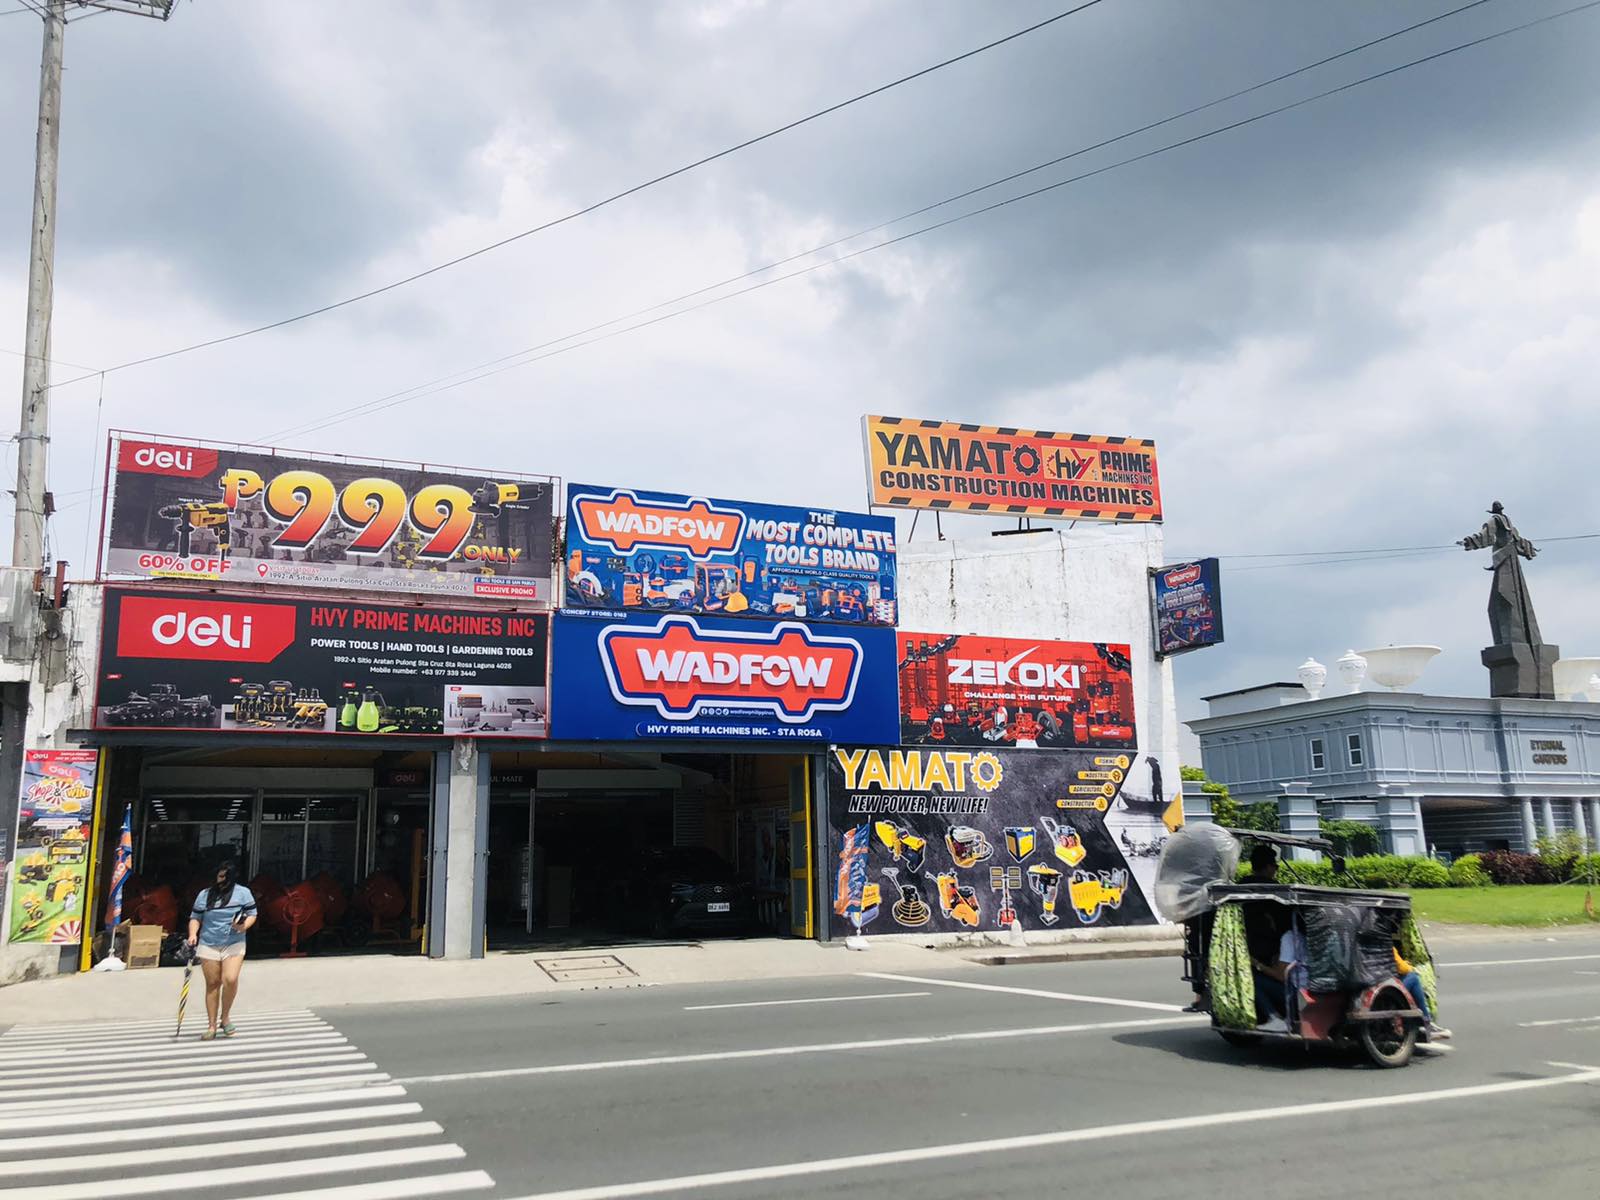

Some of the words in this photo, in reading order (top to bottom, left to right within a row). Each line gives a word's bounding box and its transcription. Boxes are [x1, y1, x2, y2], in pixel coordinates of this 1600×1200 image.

[134, 447, 193, 471] deli
[876, 431, 1041, 477] YAMATO
[1100, 450, 1152, 473] PRIME
[880, 470, 1047, 499] CONSTRUCTION
[1051, 483, 1154, 506] MACHINES
[1102, 472, 1139, 485] MACHINES
[1140, 474, 1153, 485] INC
[596, 510, 725, 541] WADFOW
[808, 511, 835, 525] THE
[746, 518, 800, 544] MOST
[802, 523, 896, 553] COMPLETE
[139, 554, 185, 572] 60%
[190, 557, 232, 574] OFF
[464, 544, 522, 565] ONLY
[765, 543, 819, 567] TOOLS
[822, 548, 880, 572] BRAND
[772, 567, 804, 575] AFFORDABLE
[476, 585, 510, 594] EXCLUSIVE
[510, 587, 534, 596] PROMO
[152, 611, 253, 649] deli
[310, 607, 349, 628] HVY
[353, 609, 409, 632] PRIME
[413, 613, 502, 636] MACHINES
[507, 618, 535, 637] INC
[310, 638, 346, 649] POWER
[348, 640, 379, 650] TOOLS
[386, 642, 413, 652] HAND
[415, 644, 445, 654] TOOLS
[451, 645, 503, 656] GARDENING
[505, 647, 534, 656] TOOLS
[395, 659, 416, 667] Pulong
[473, 662, 495, 670] Laguna
[636, 648, 833, 688] WADFOW
[964, 691, 1016, 700] CHALLENGE
[1018, 692, 1036, 700] THE
[1038, 694, 1072, 702] FUTURE
[647, 725, 668, 734] HVY
[670, 725, 700, 734] PRIME
[701, 726, 751, 735] MACHINES
[752, 727, 771, 736] INC.
[777, 728, 796, 736] STA
[797, 728, 822, 737] ROSA
[836, 748, 1003, 792] YAMATO
[849, 794, 881, 813] NEW
[880, 795, 928, 815] POWER,
[929, 796, 961, 813] NEW
[959, 796, 990, 814] LIFE!
